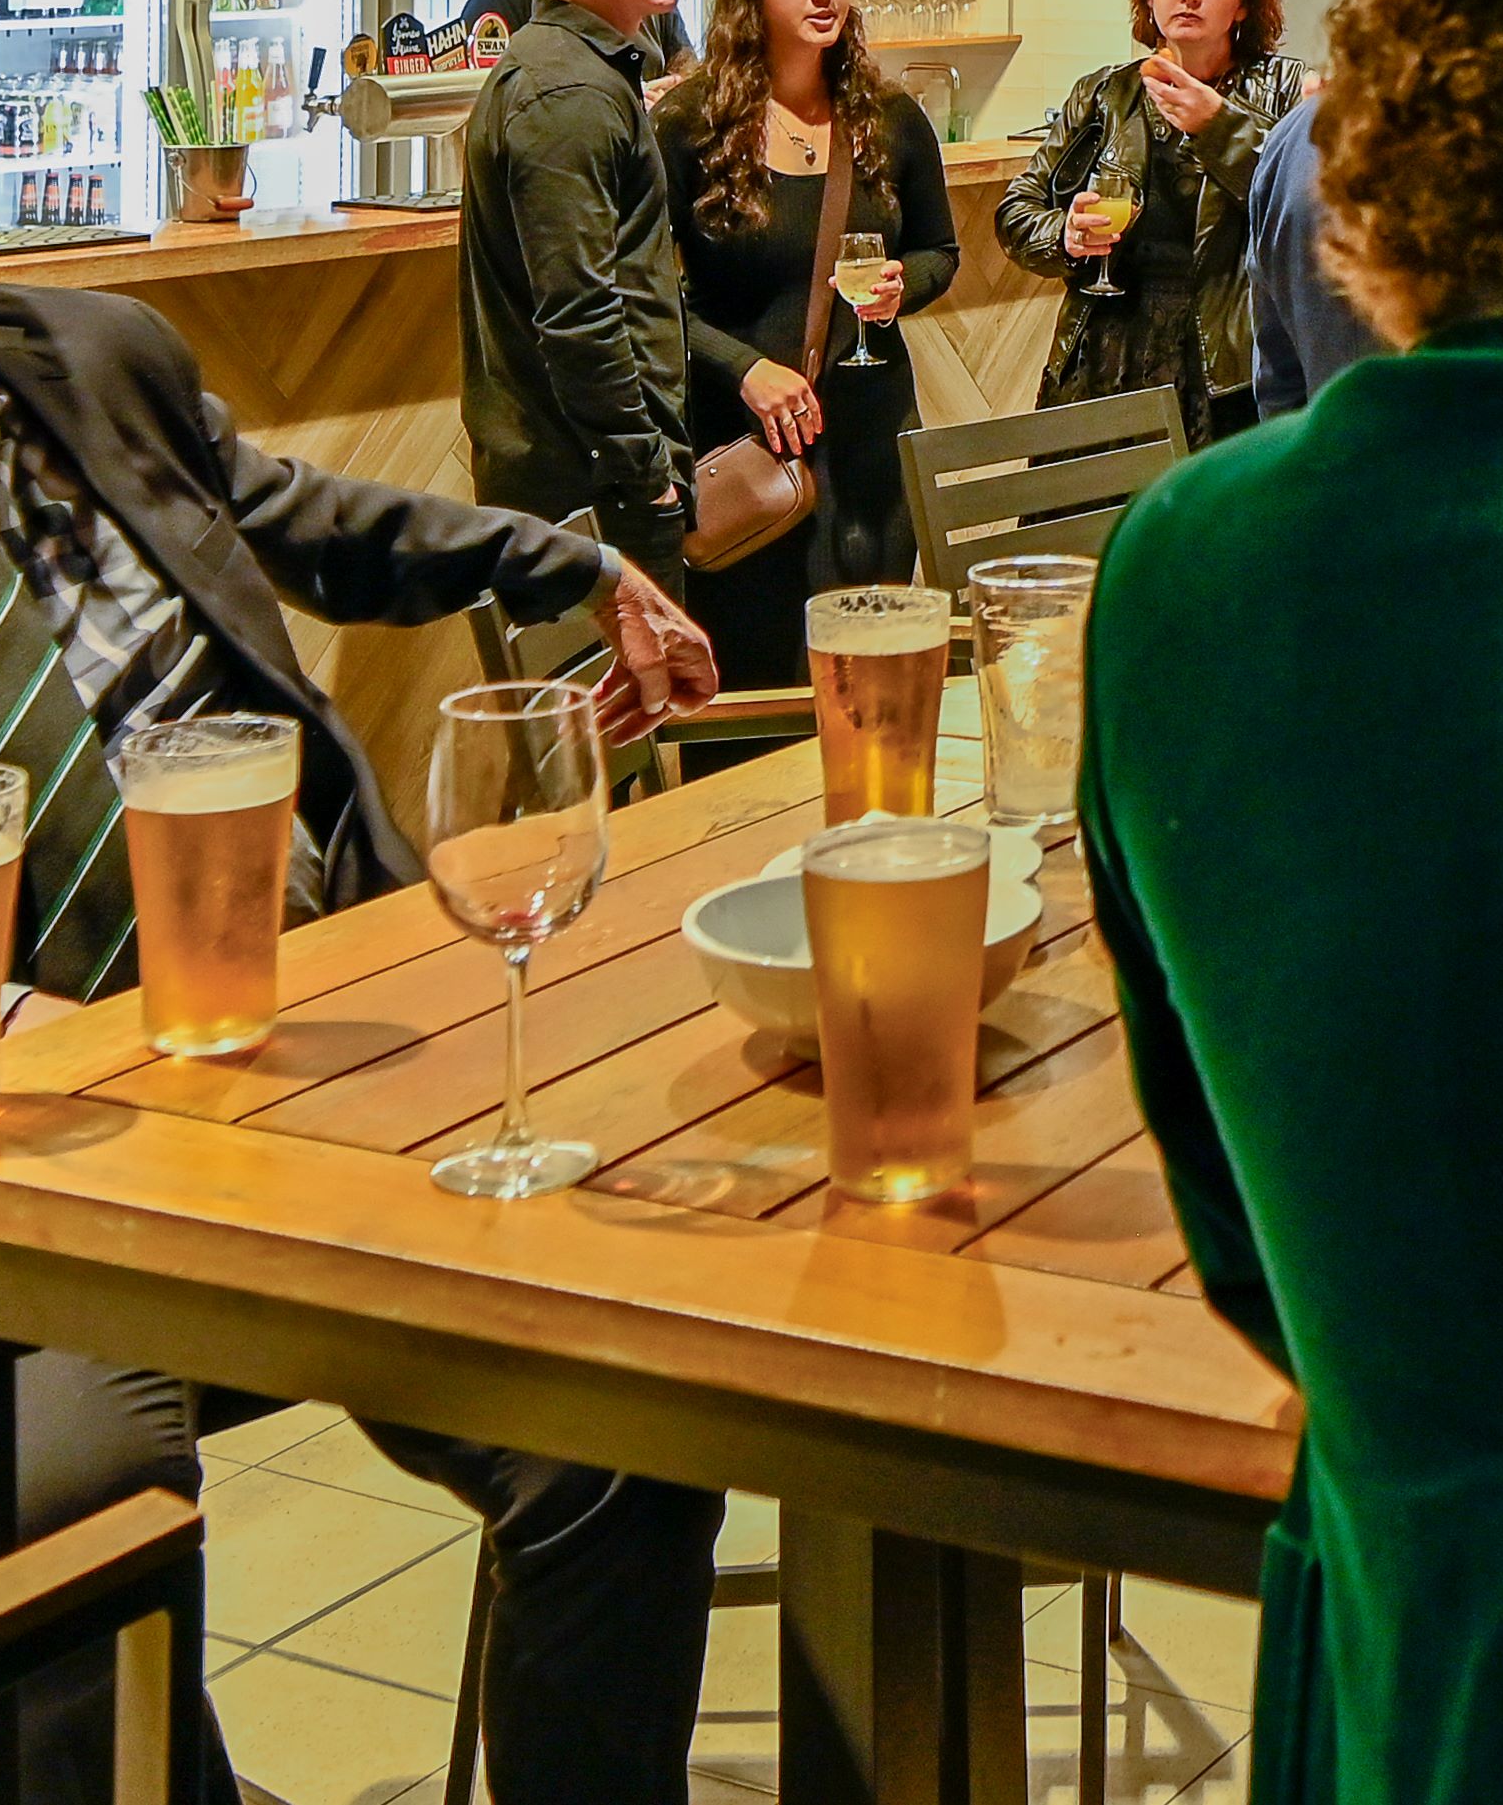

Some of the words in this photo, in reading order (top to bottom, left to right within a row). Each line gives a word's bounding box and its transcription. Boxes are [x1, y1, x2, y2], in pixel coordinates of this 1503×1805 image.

[426, 19, 467, 58] HAHN
[478, 40, 505, 50] SWAN
[394, 57, 426, 74] GINGER
